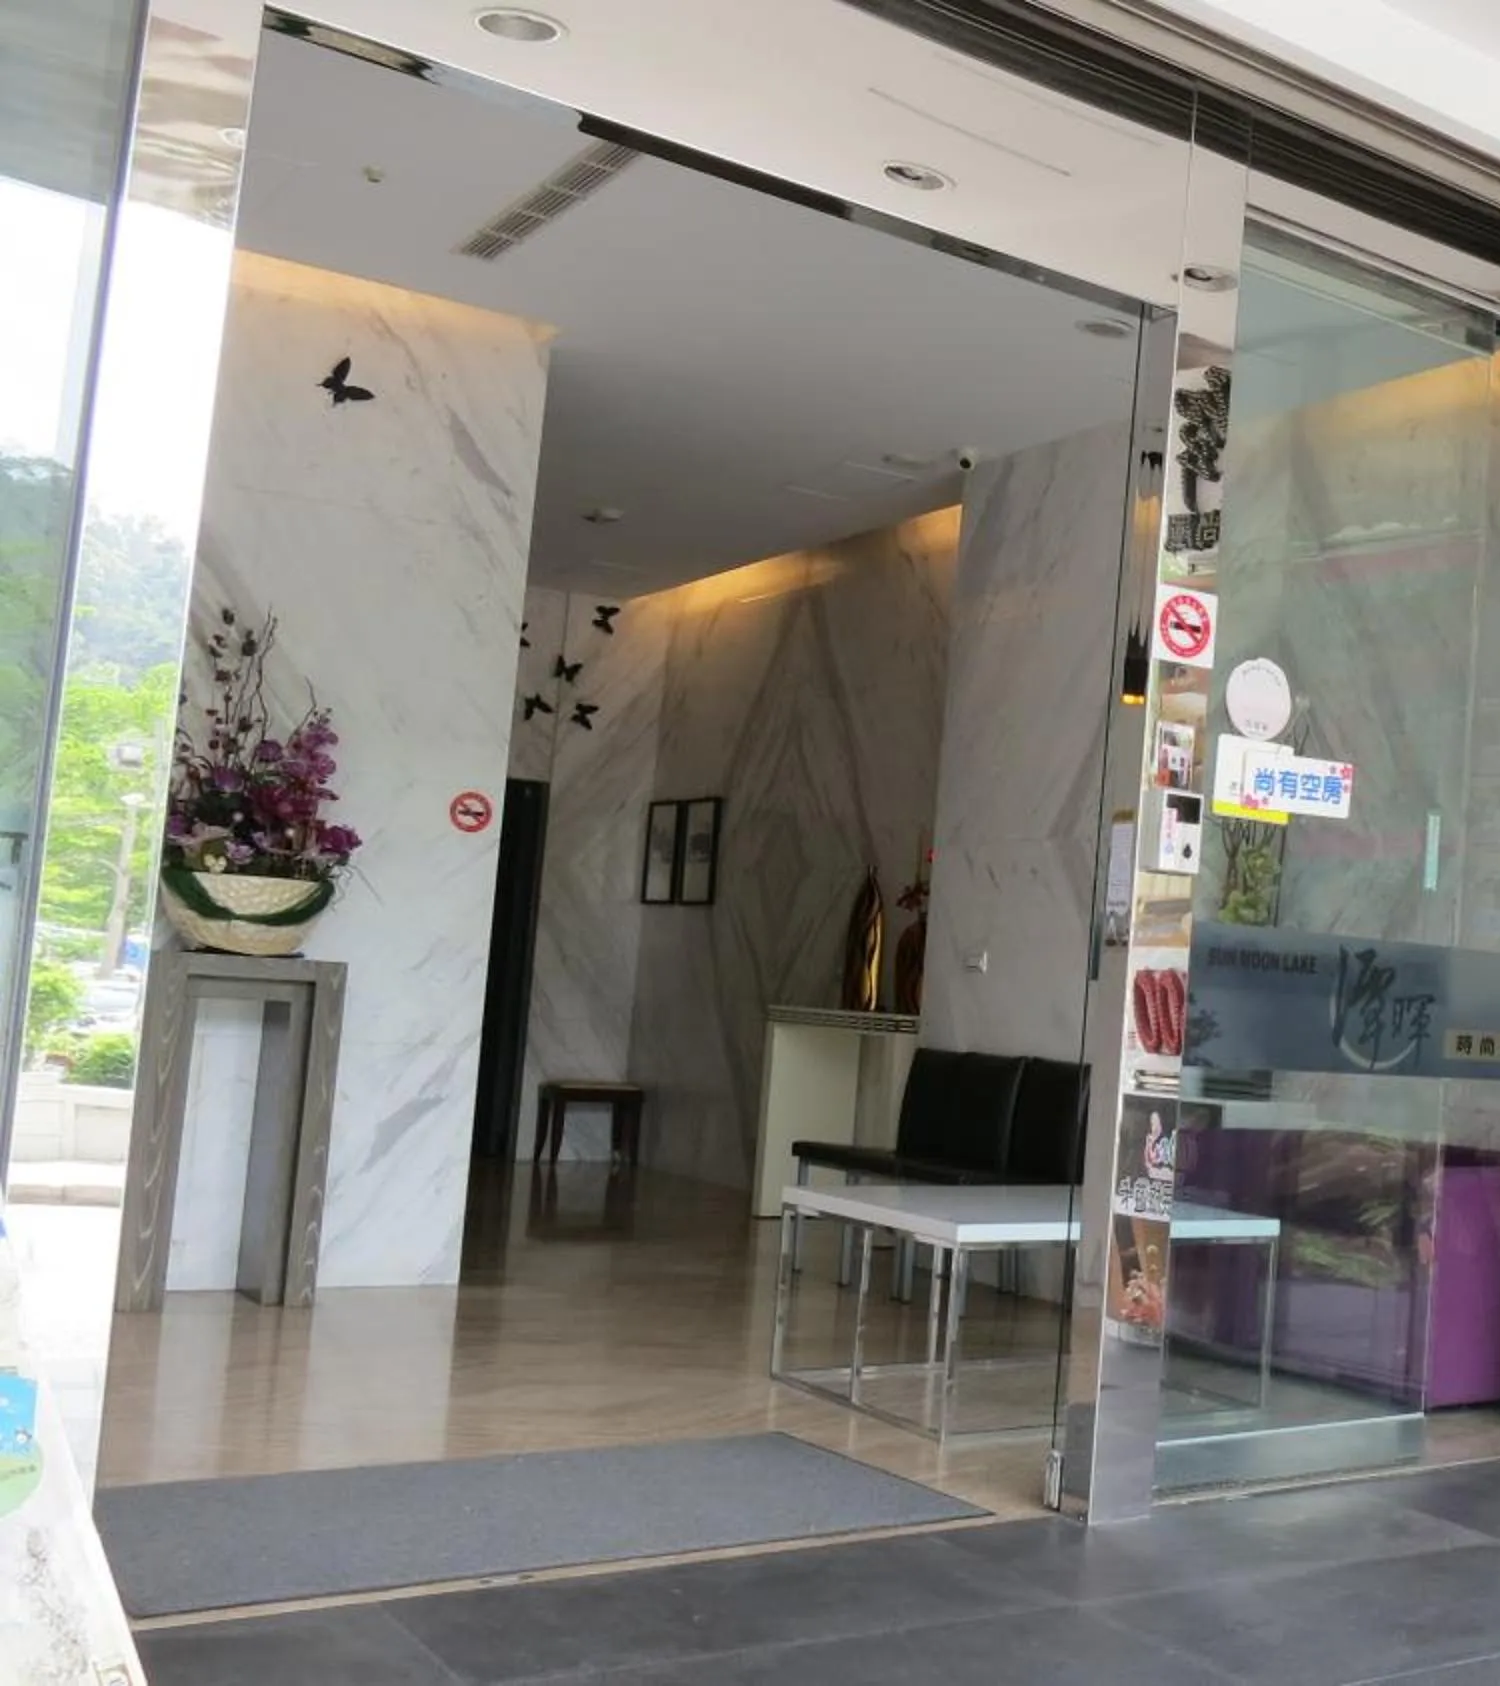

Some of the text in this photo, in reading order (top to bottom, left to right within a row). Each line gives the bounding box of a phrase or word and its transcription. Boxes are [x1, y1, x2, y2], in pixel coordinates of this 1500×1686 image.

[1254, 767, 1343, 805] 尚有空房
[1207, 947, 1318, 975] SUN MOON LAKE
